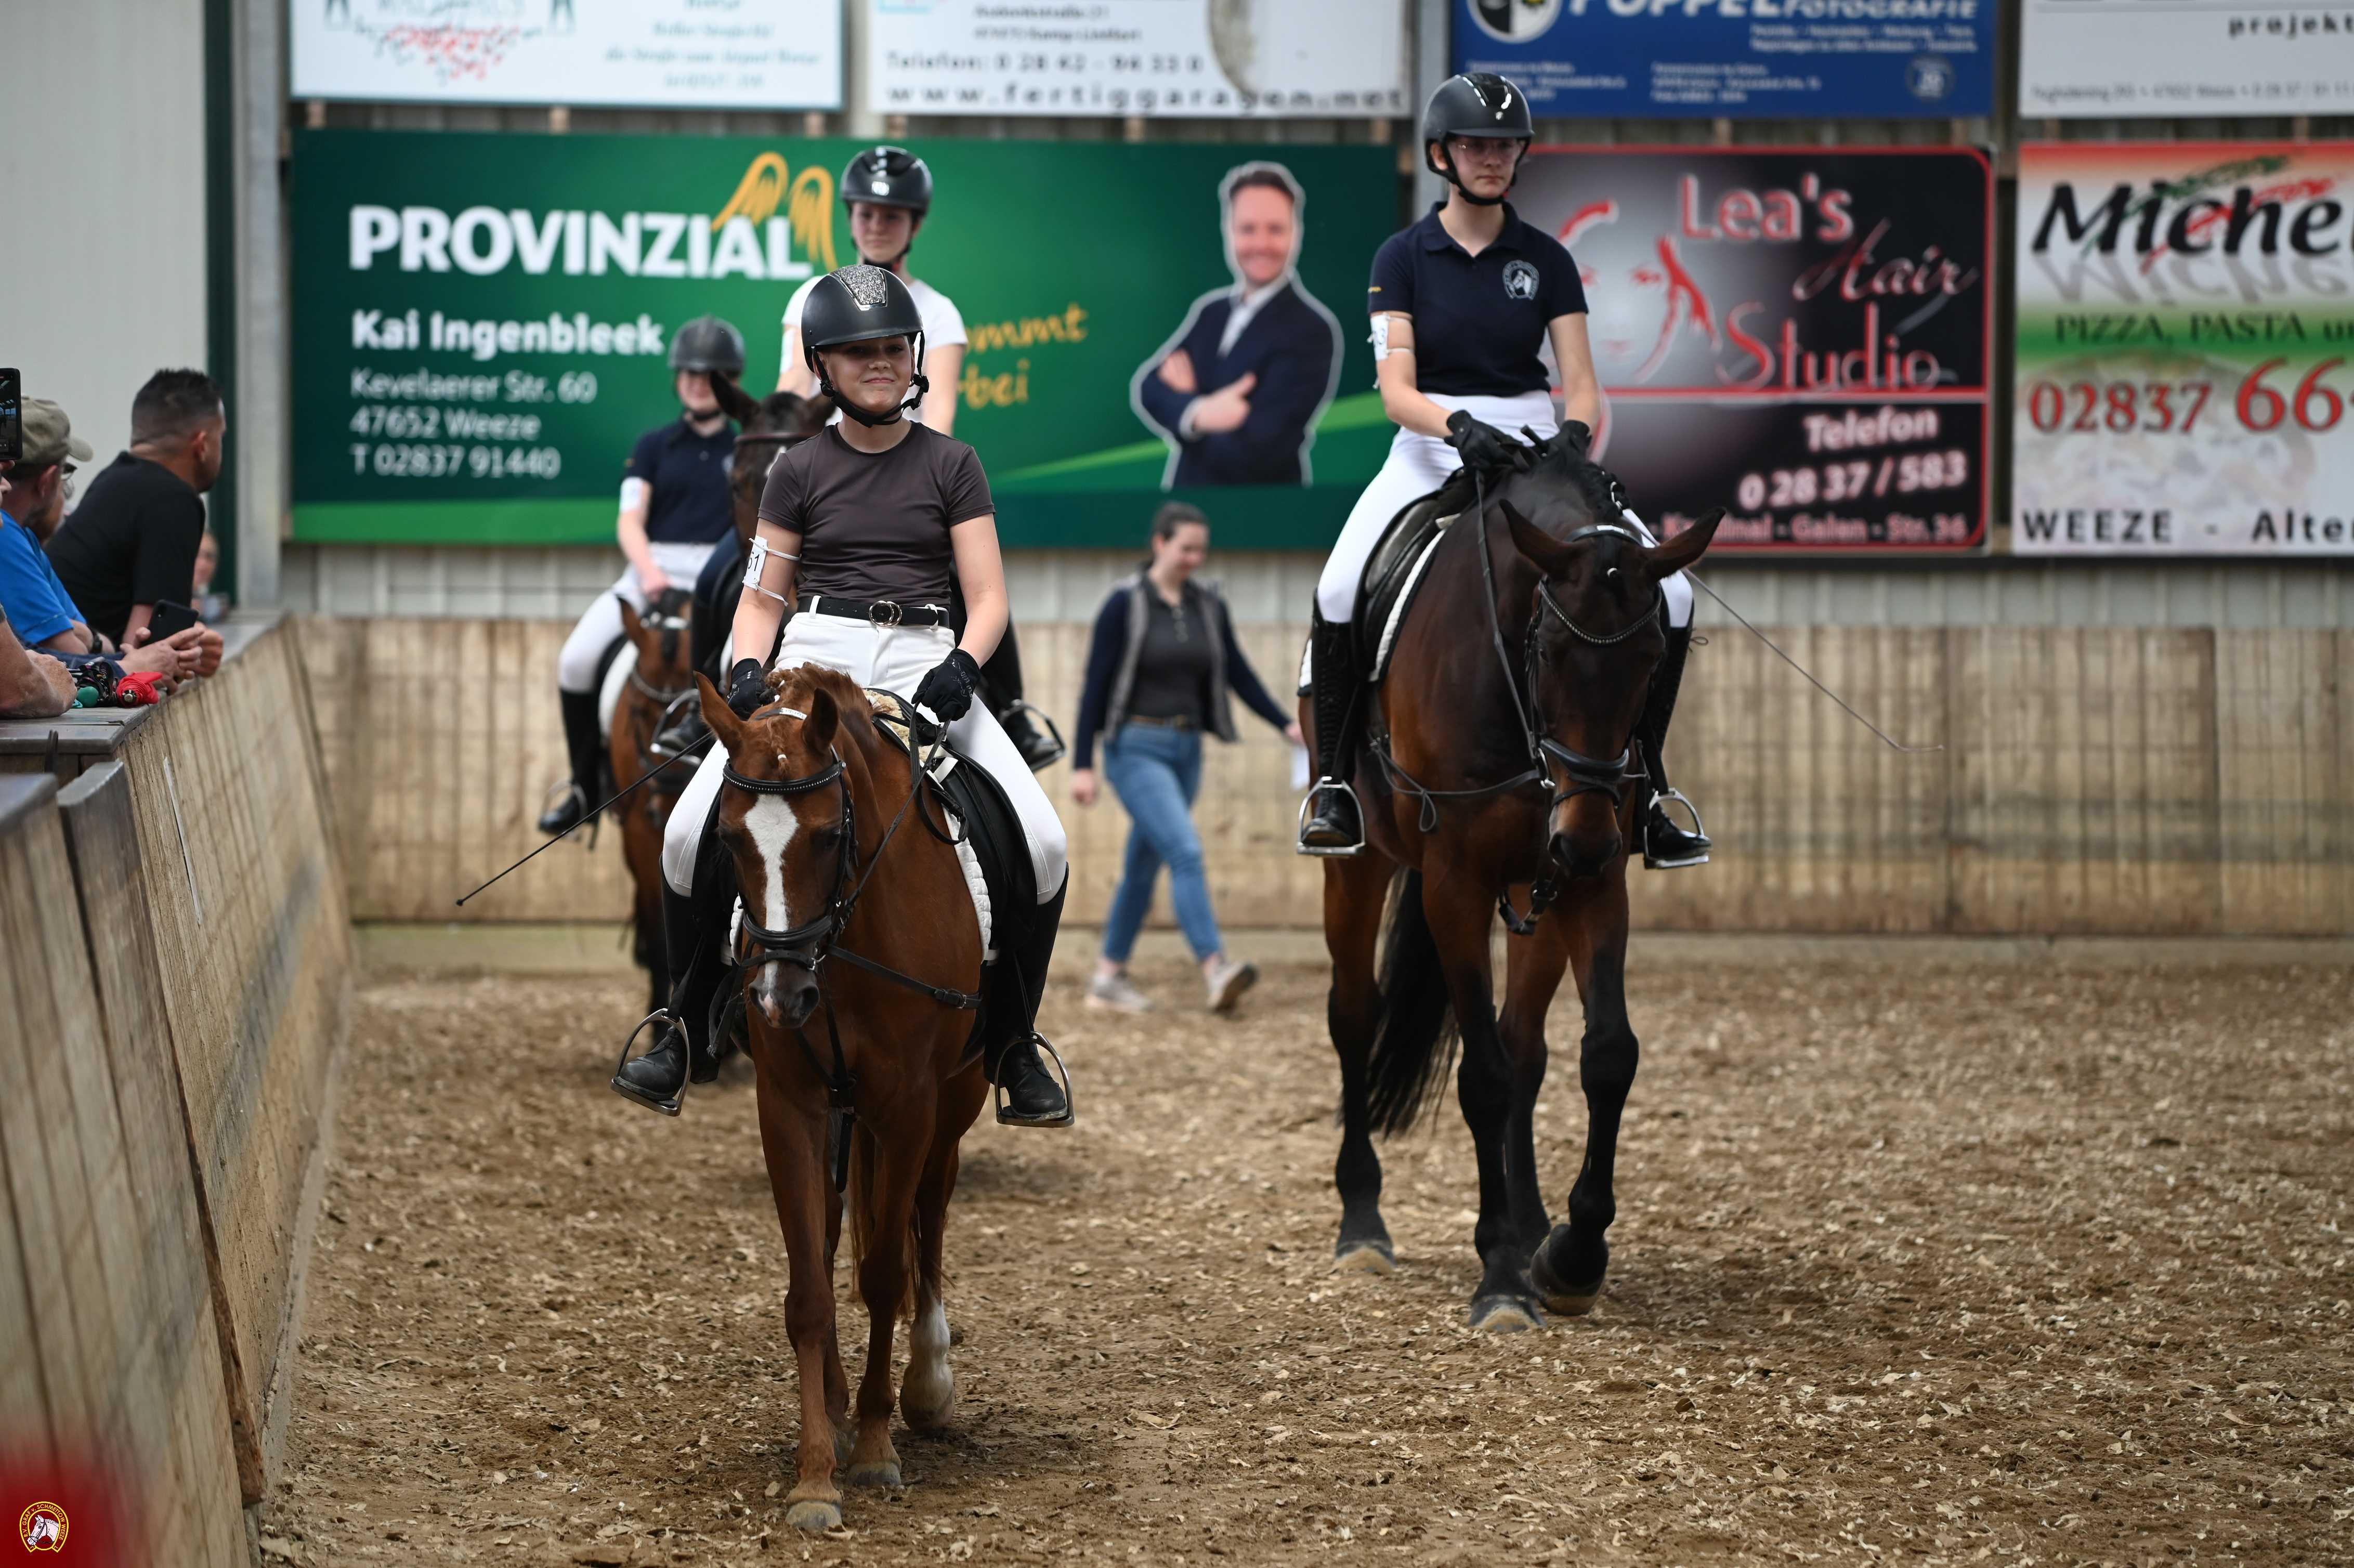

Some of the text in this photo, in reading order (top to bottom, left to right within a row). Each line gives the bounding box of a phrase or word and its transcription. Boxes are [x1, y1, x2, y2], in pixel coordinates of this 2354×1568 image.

[1680, 173, 1854, 242] Lea's
[2032, 180, 2354, 256] Miche
[349, 205, 813, 280] PROVINZIAL
[351, 309, 666, 361] Kai Ingenbleek
[1716, 301, 1942, 391] Studio
[2189, 311, 2307, 344] PASTA
[350, 367, 598, 404] Kevelaerer Str. 60
[2029, 356, 2354, 434] 02837 66
[349, 405, 542, 441] 47652 Weeze
[1802, 404, 1939, 452] Telefon
[349, 442, 562, 480] T 02837 91440
[1737, 473, 1766, 511] 0
[1897, 449, 1969, 492] 583
[2022, 508, 2173, 544] WEEZE
[2251, 507, 2354, 543] Alte
